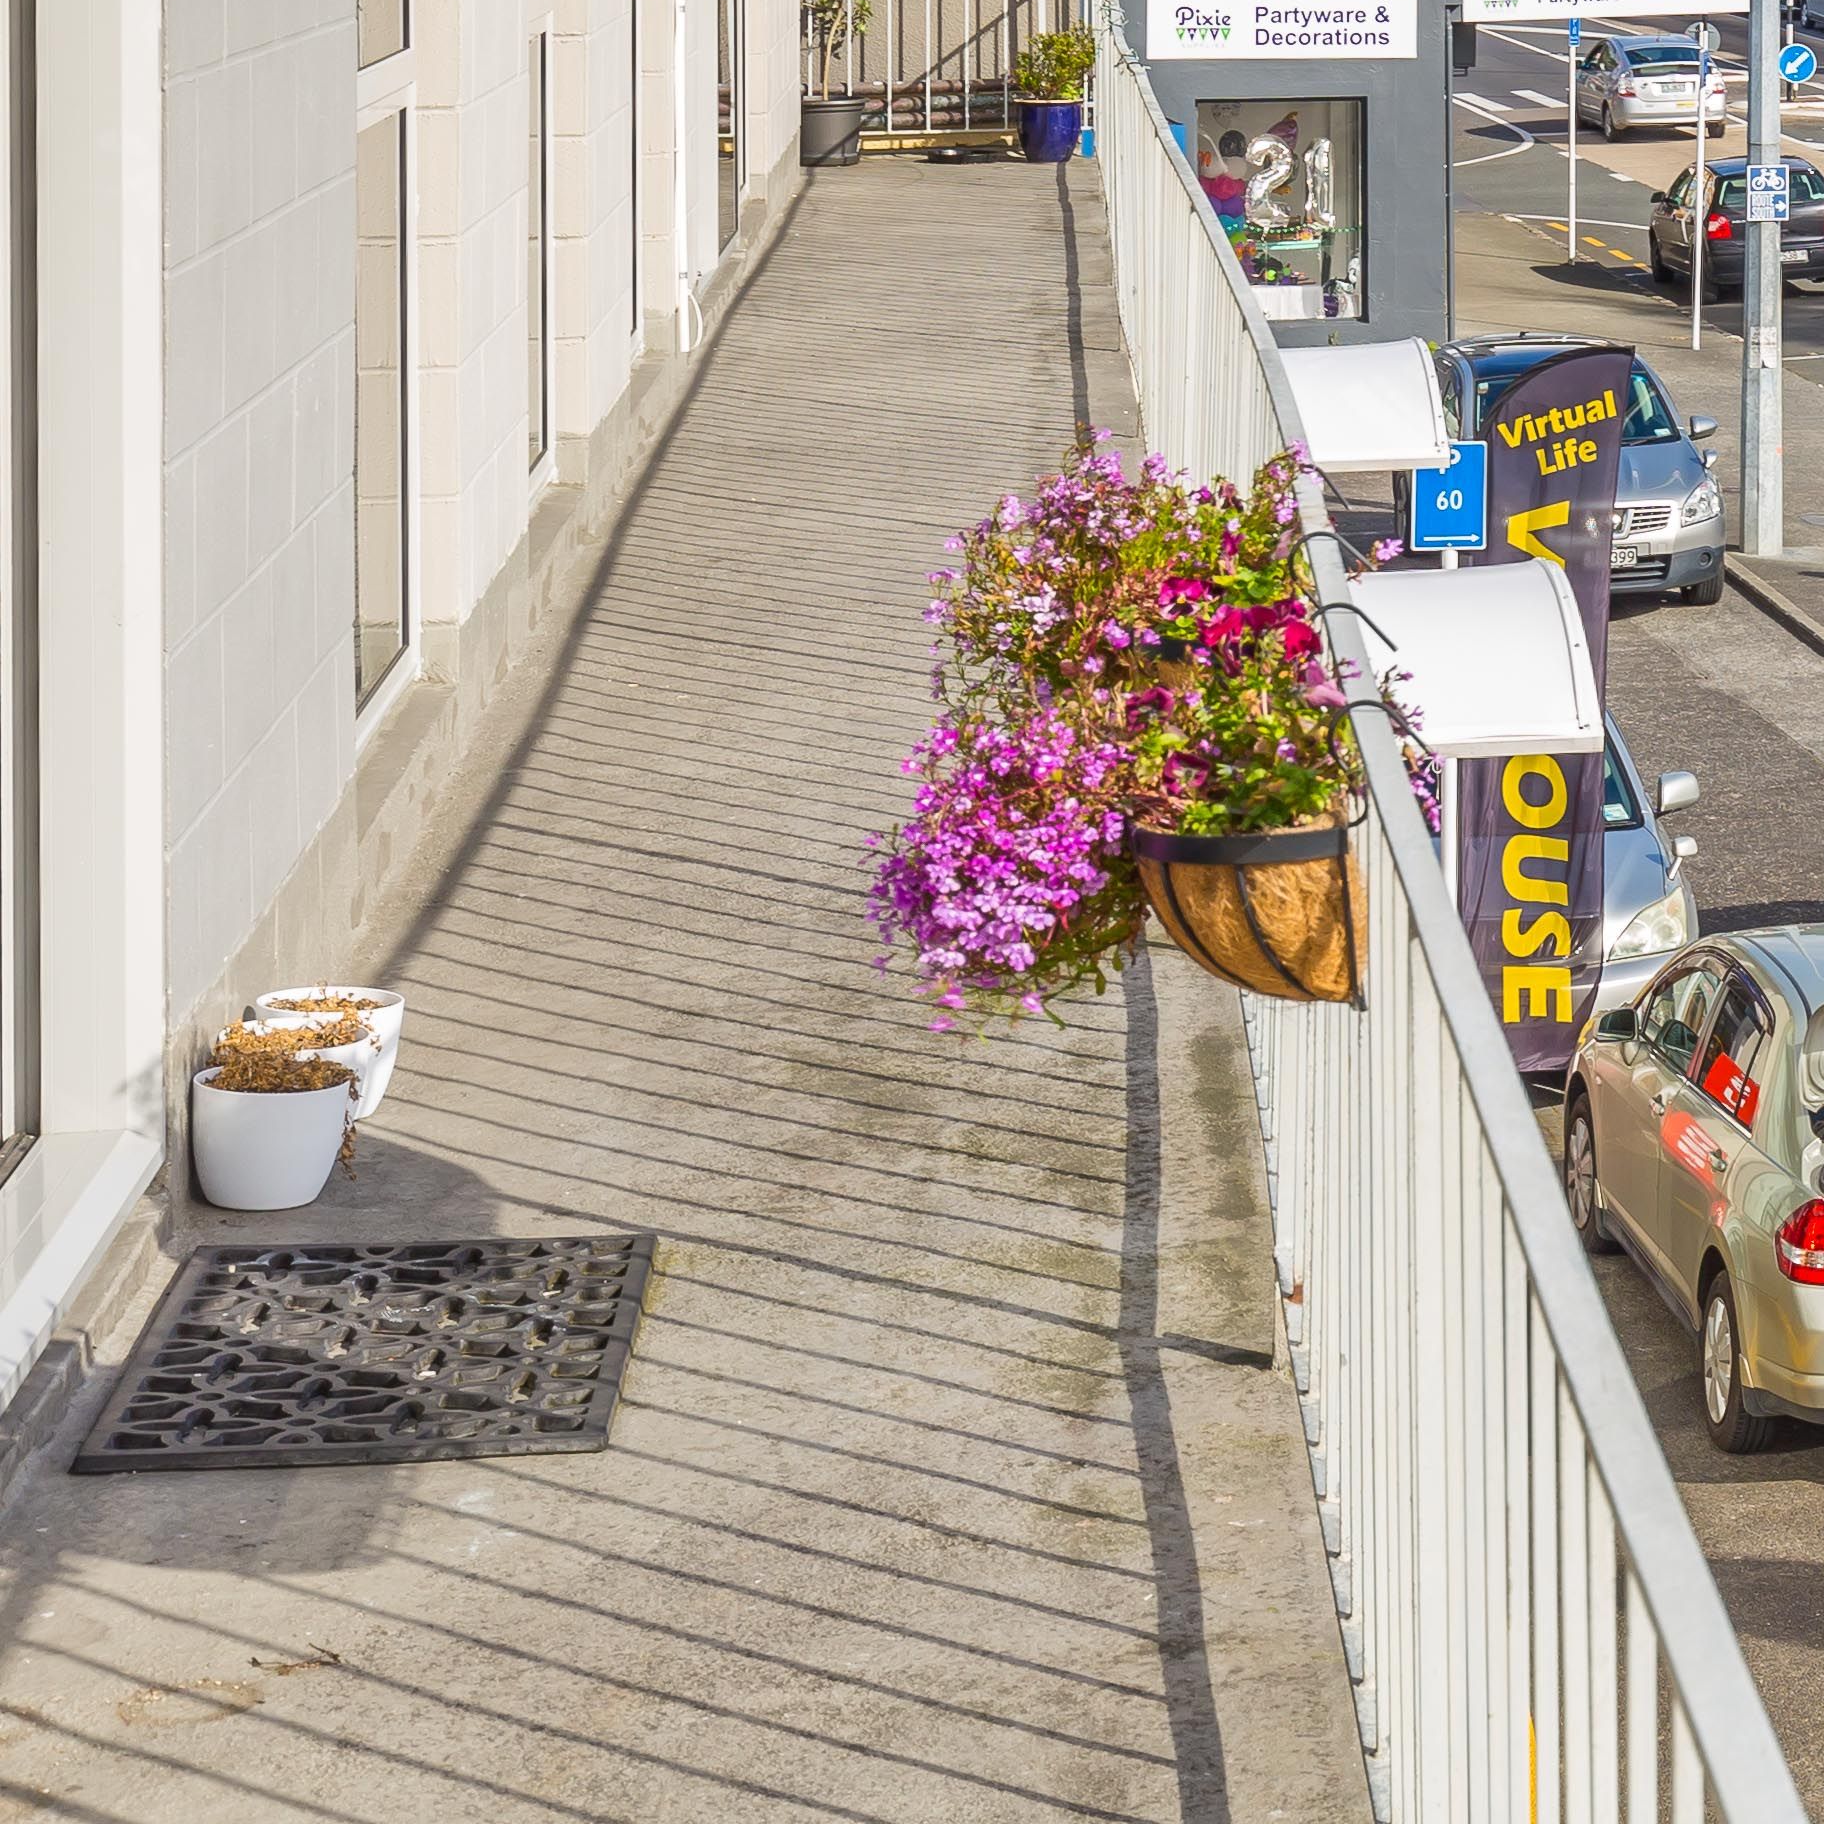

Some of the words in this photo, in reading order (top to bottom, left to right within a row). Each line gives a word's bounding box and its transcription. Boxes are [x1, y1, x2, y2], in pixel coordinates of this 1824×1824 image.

[1175, 6, 1231, 26] Pixie
[1254, 6, 1367, 27] Partyware
[1374, 5, 1390, 24] &
[1254, 28, 1391, 46] Decorations
[1496, 389, 1618, 449] Virtual
[1535, 437, 1598, 476] Life
[1436, 489, 1463, 511] 60
[1610, 551, 1635, 564] 399
[1502, 753, 1574, 1024] OUSE
